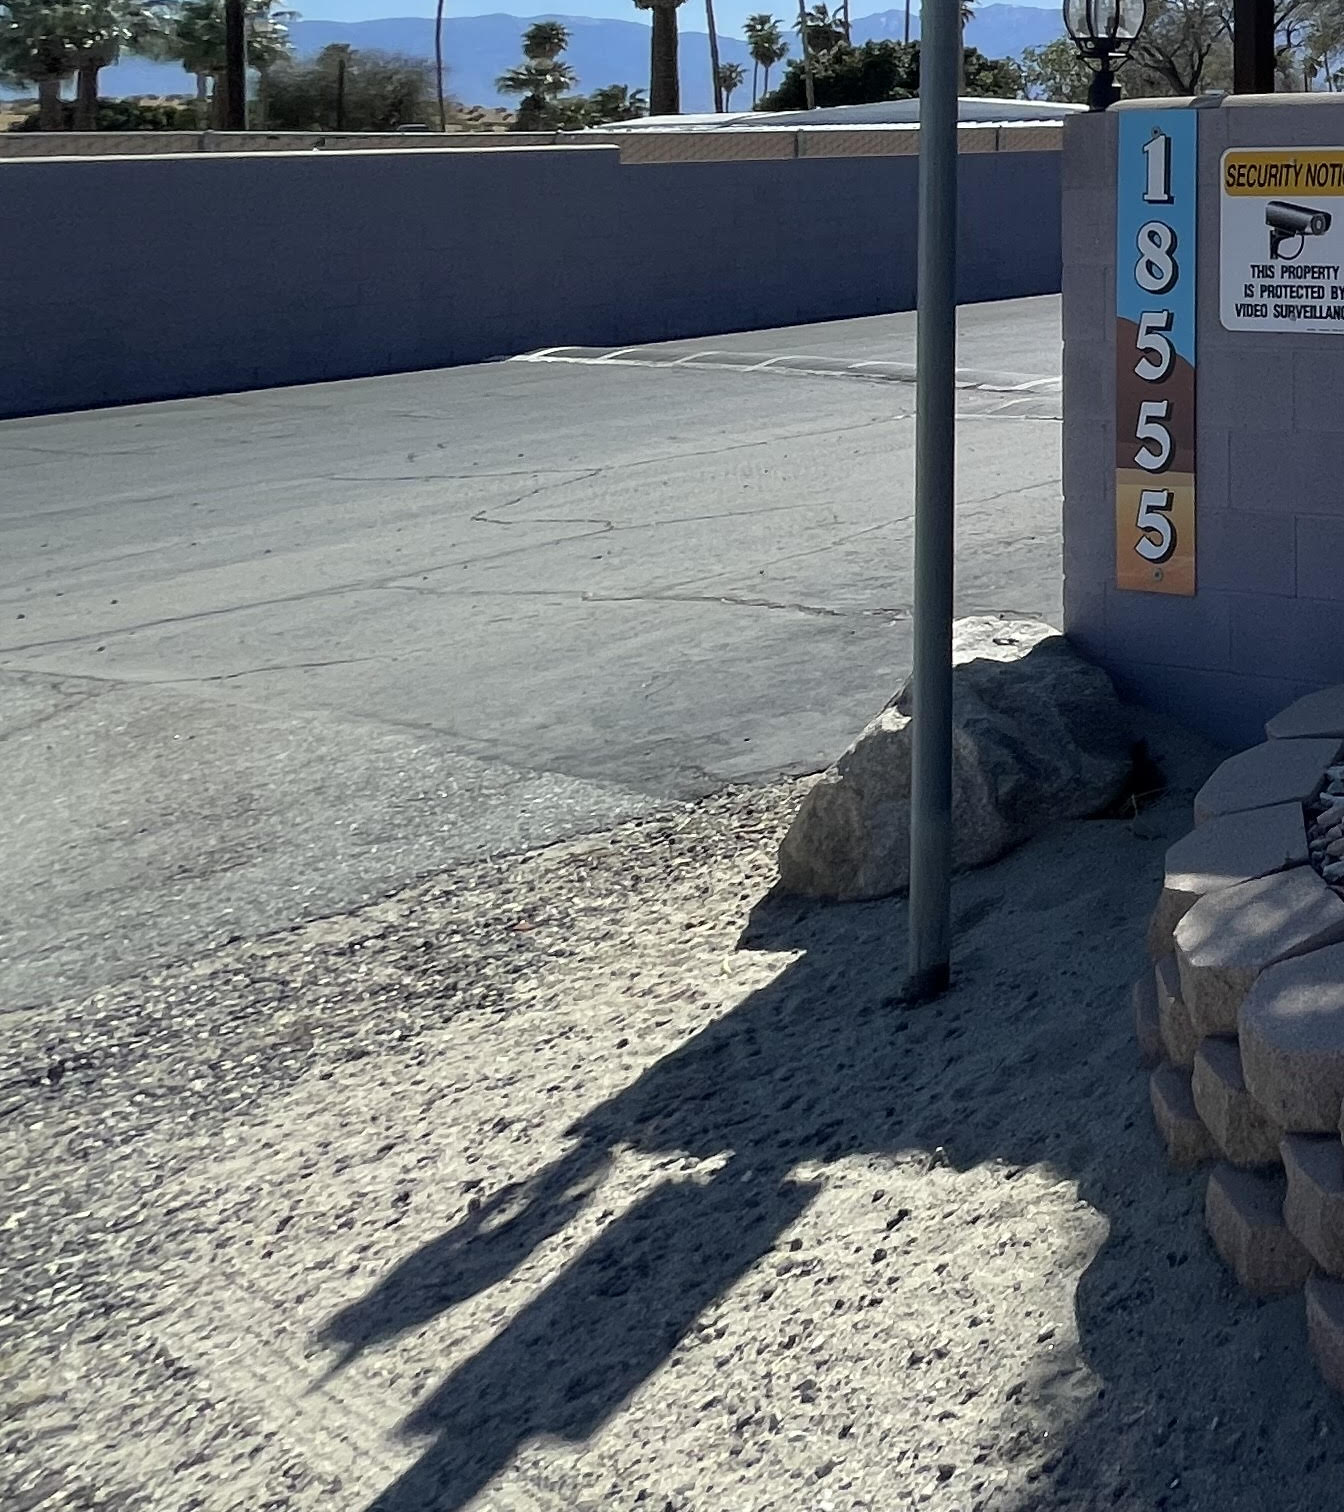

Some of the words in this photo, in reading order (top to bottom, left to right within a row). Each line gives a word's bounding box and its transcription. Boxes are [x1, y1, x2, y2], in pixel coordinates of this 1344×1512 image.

[1226, 162, 1304, 188] SECURITY
[1250, 264, 1275, 280] THIS
[1280, 265, 1340, 281] PROPERTY
[1244, 283, 1255, 298] IS
[1259, 284, 1325, 300] PROTECTED
[1234, 303, 1269, 318] VIDEO
[1133, 132, 1180, 564] 18555
